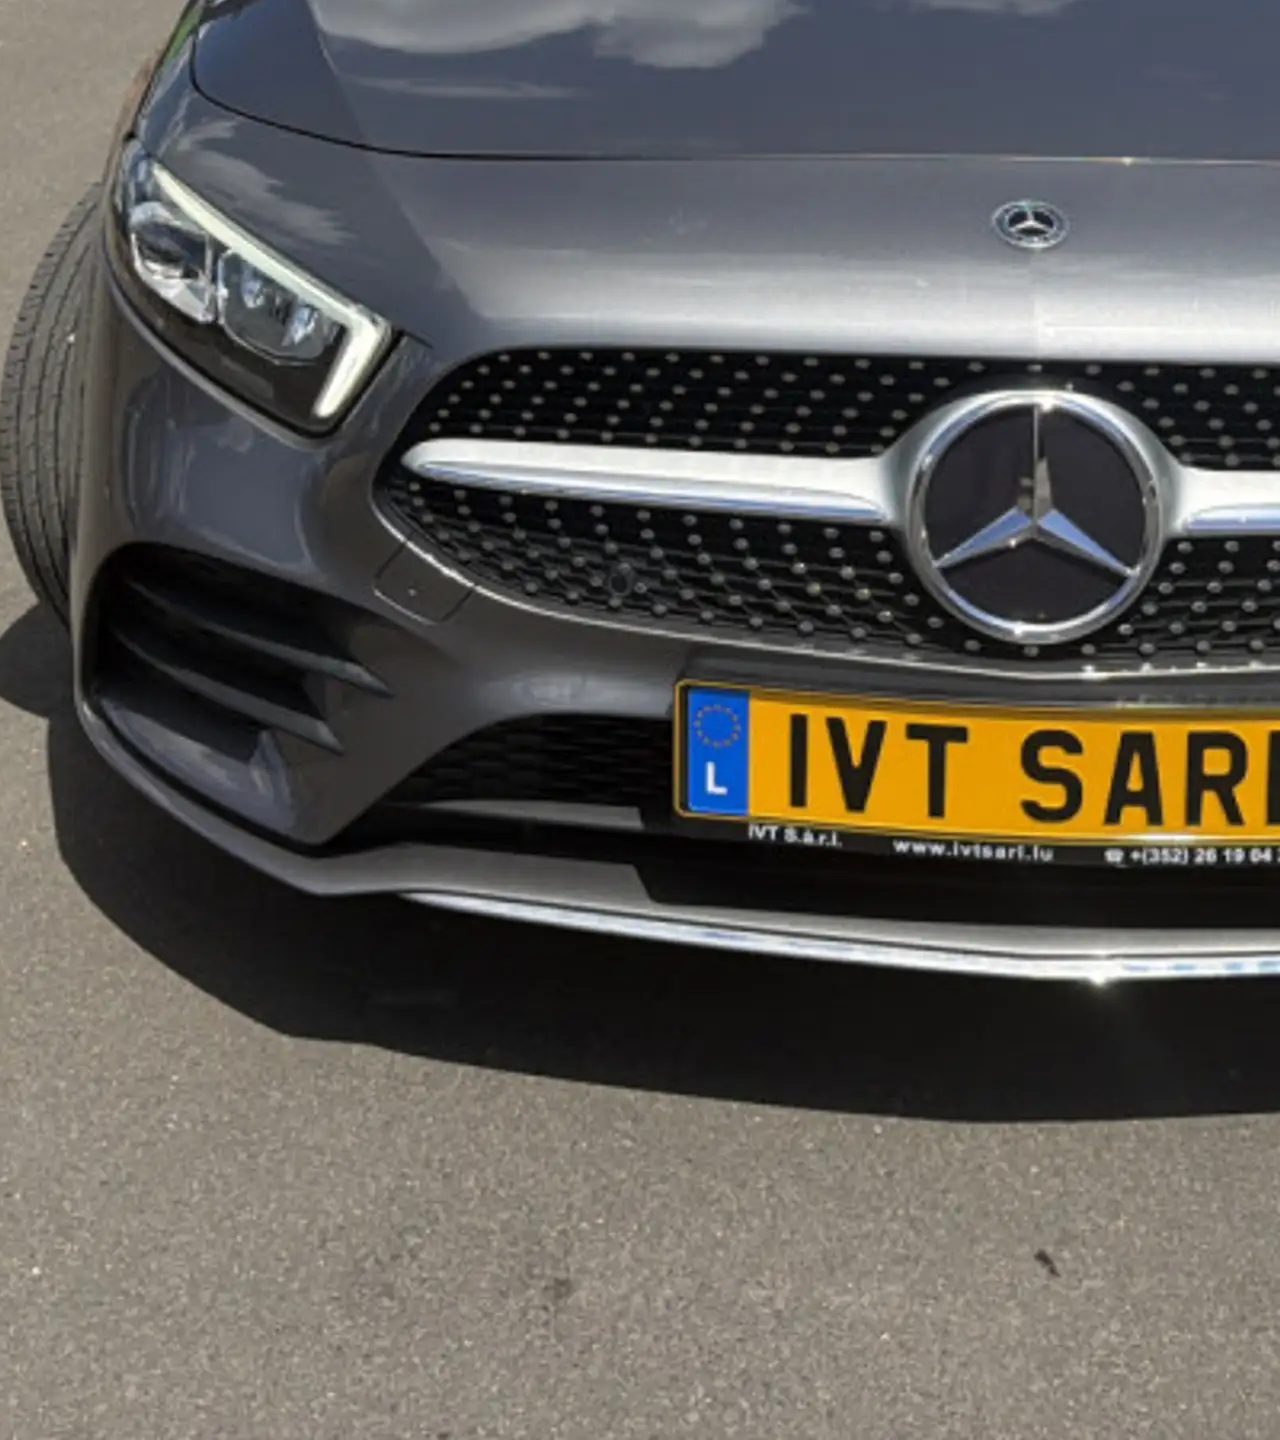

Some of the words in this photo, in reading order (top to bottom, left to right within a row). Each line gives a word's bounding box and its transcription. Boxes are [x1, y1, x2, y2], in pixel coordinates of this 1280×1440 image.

[788, 713, 968, 819] IVT
[706, 762, 728, 796] L
[747, 823, 778, 841] IVT
[892, 839, 1055, 863] www.ivtsarl.lu
[1193, 848, 1218, 864] 26
[1223, 847, 1246, 864] 19
[1249, 847, 1273, 864] 04
